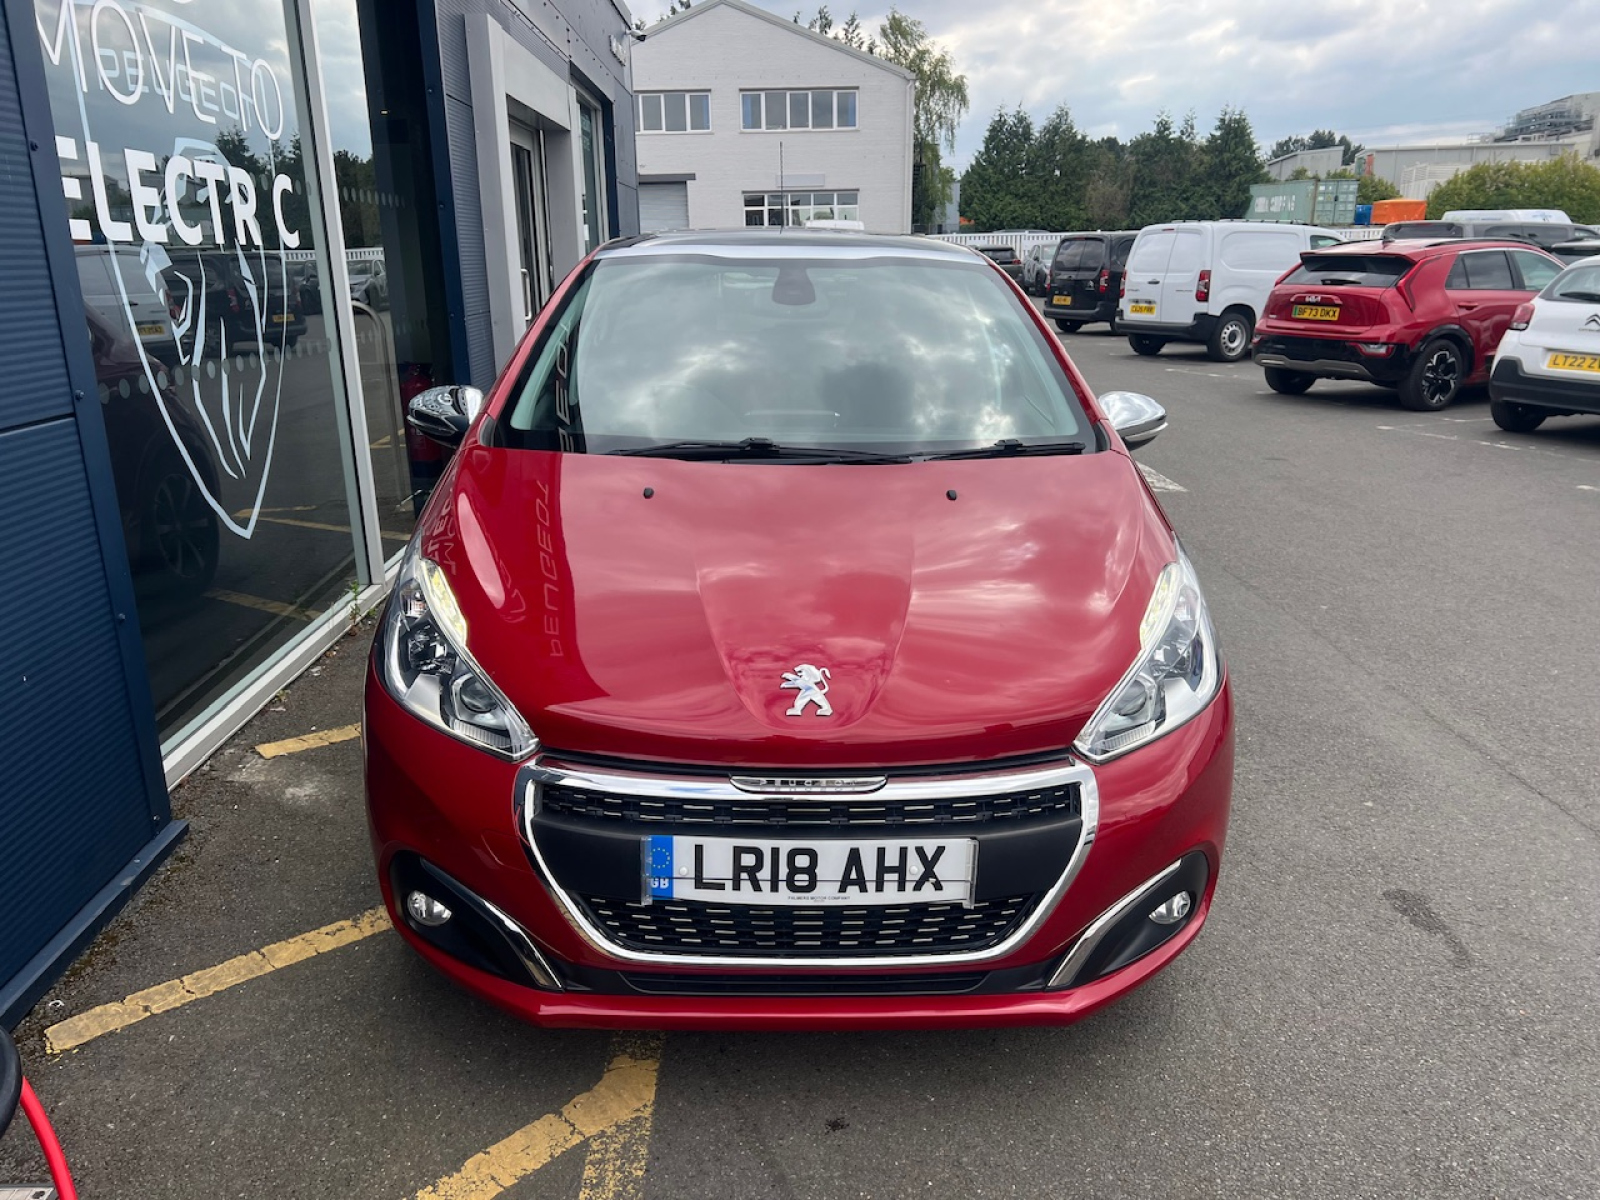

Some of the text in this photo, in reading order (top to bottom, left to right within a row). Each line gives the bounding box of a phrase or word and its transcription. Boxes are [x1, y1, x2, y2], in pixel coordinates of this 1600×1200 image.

[221, 45, 283, 140] TO
[1297, 306, 1318, 317] BF73
[1553, 354, 1600, 370] LT22 Z
[694, 844, 946, 893] LR18 AHX
